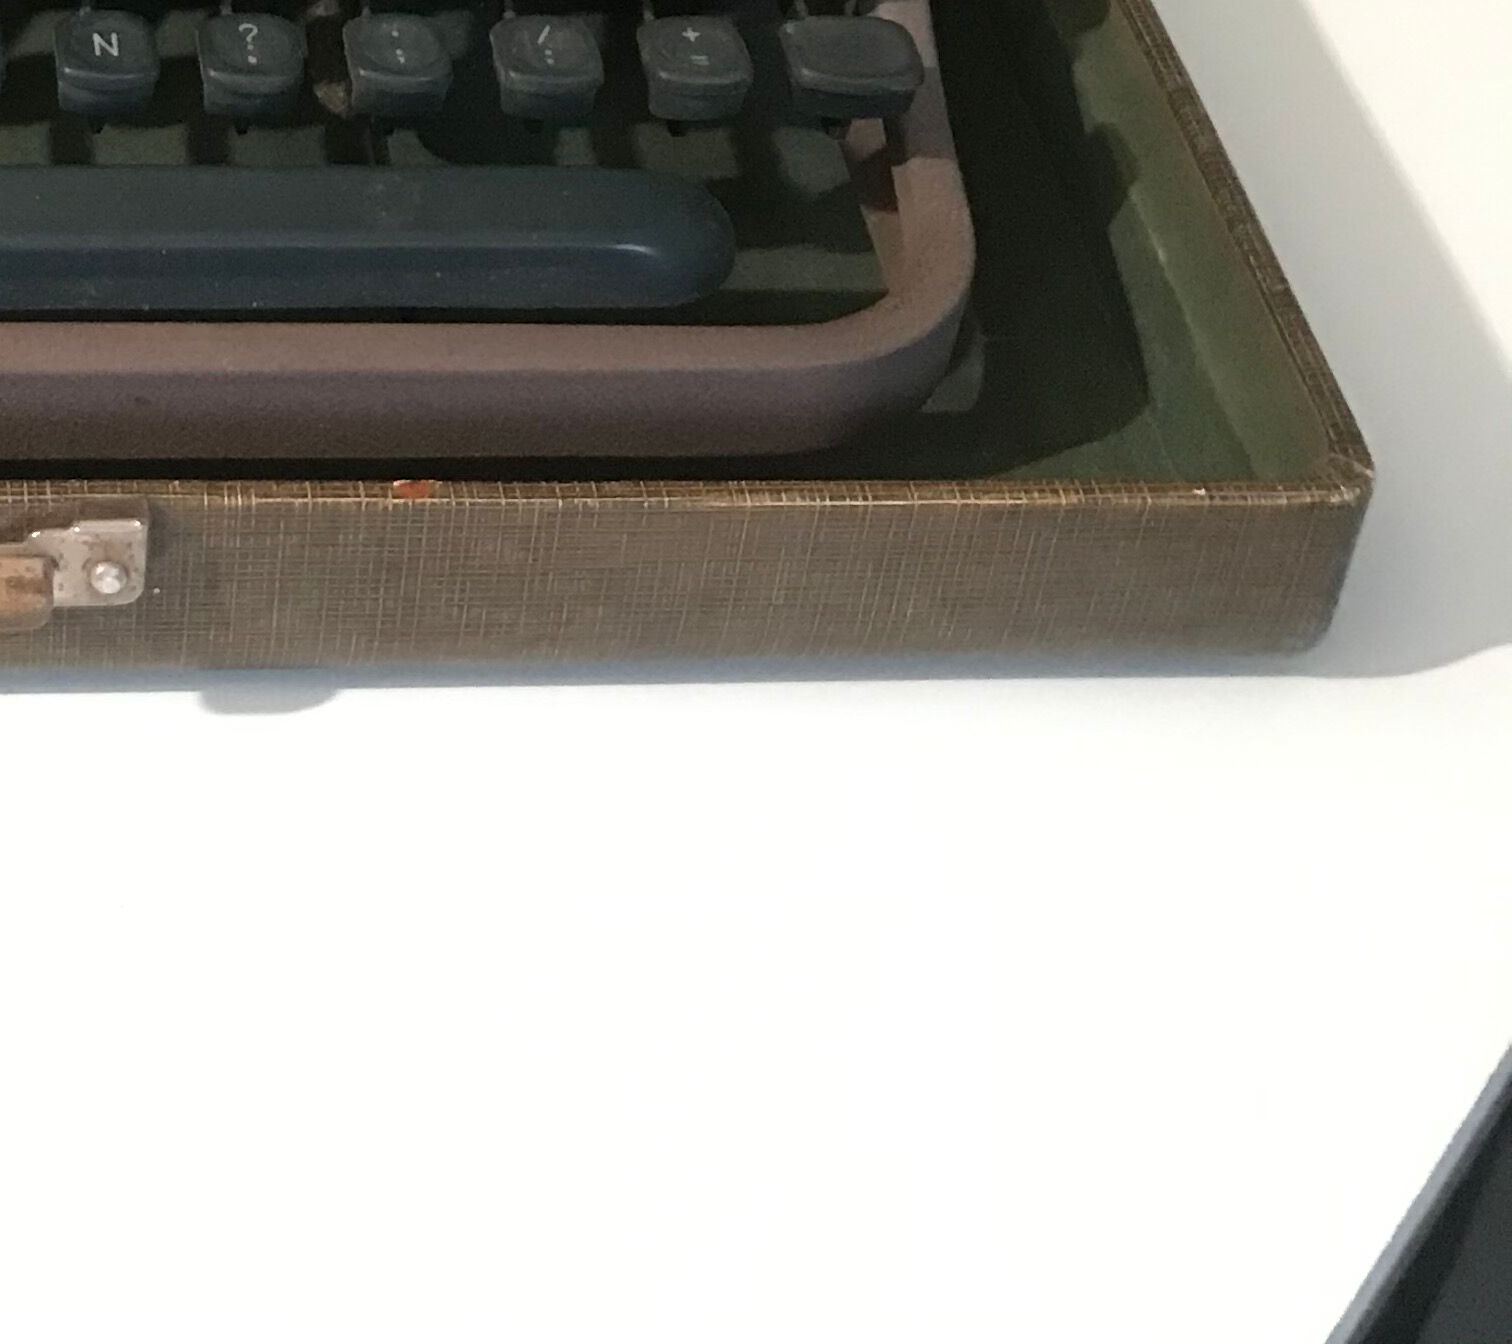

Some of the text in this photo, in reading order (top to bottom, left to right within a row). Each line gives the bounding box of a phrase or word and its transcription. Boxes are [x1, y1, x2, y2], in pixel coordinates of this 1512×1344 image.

[237, 22, 259, 52] ?
[537, 24, 552, 45] /
[681, 27, 702, 43] +
[92, 33, 119, 57] N
[544, 48, 556, 65] :
[689, 54, 710, 66] =
